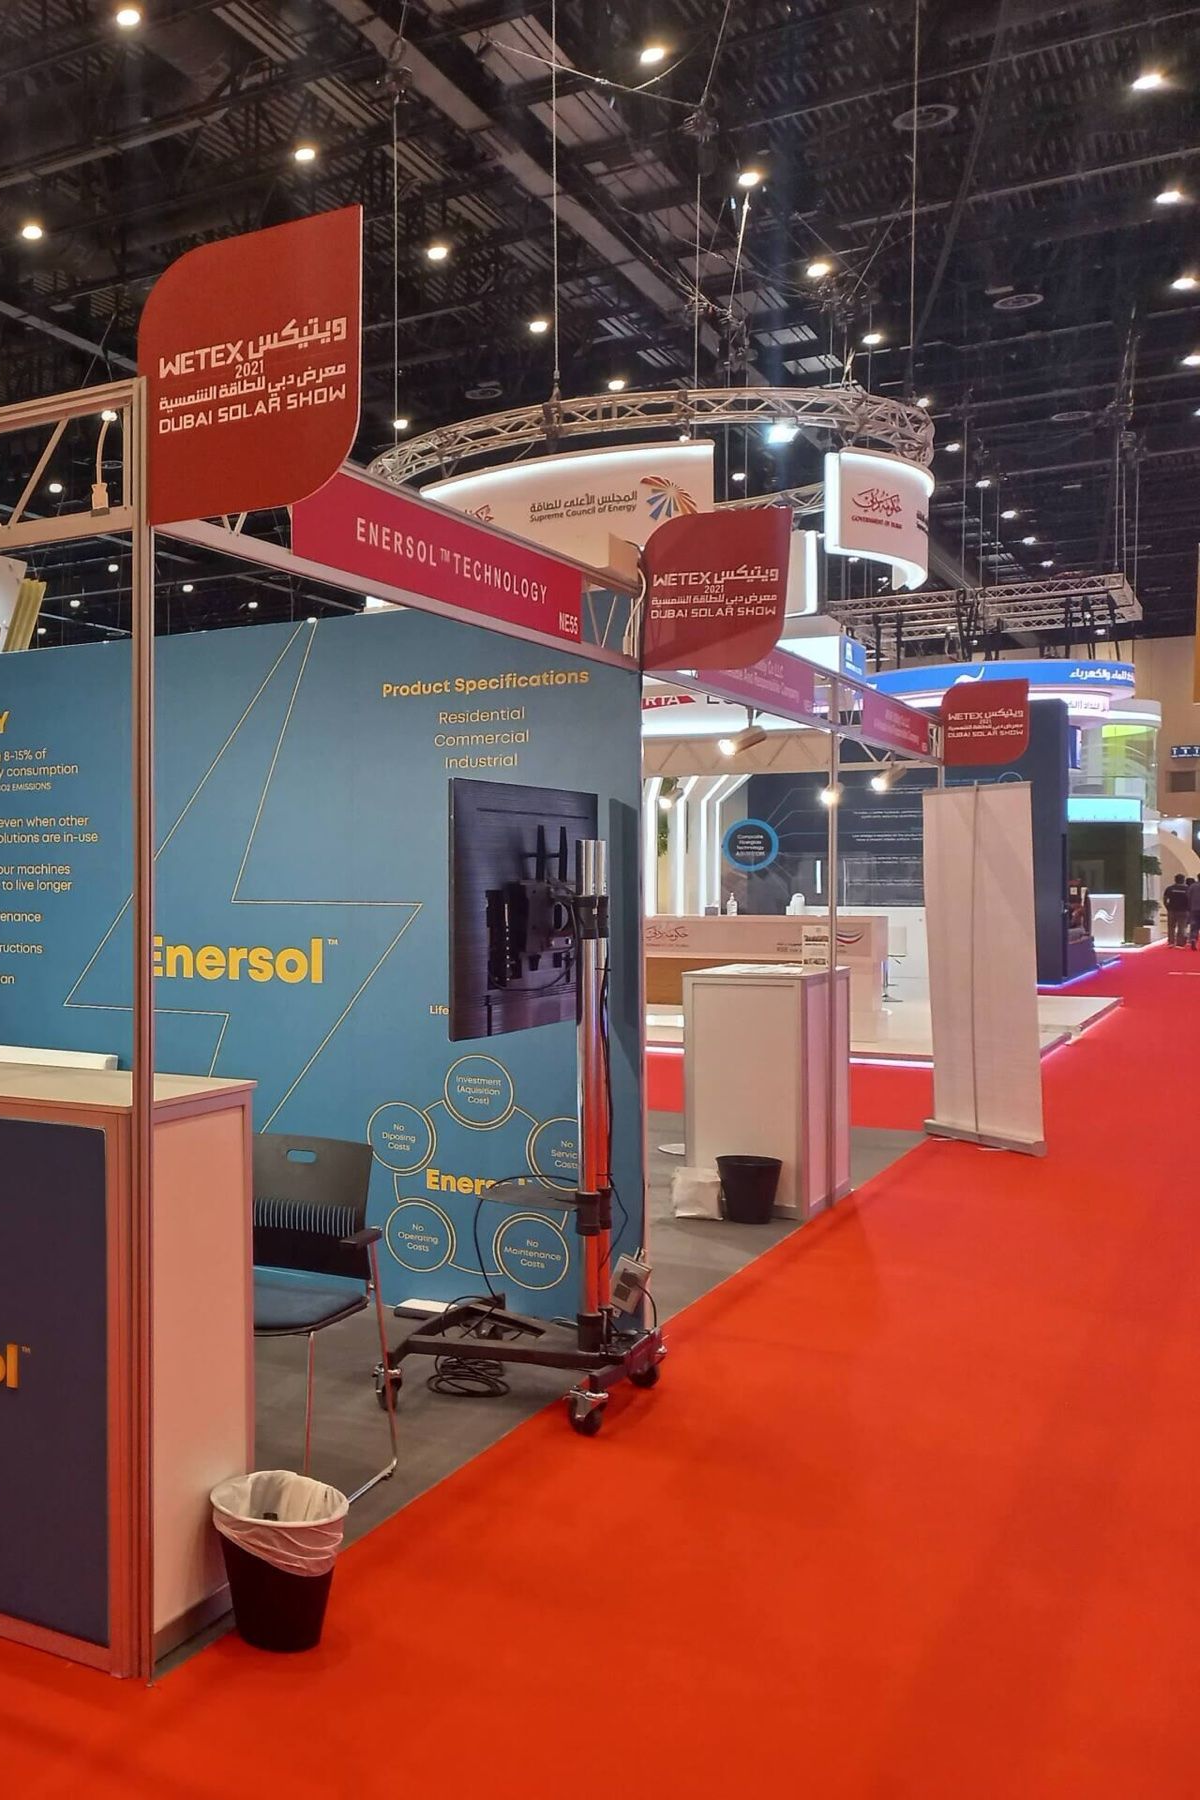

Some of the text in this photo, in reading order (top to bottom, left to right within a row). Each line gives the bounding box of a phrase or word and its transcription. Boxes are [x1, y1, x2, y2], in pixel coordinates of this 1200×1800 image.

[248, 316, 347, 360] ويتيكس
[159, 340, 244, 379] WETEX
[234, 359, 265, 378] 2021
[159, 363, 346, 413] معرض دبي للطاقة الشمسية
[159, 383, 347, 434] DUBAI SOLAR SHOW
[597, 491, 637, 506] المجلس
[530, 503, 637, 523] Supreme Council of Energy
[452, 552, 547, 604] TECHNOLOGY
[653, 571, 712, 587] WETEX
[714, 564, 779, 584] ويتيكس
[704, 584, 725, 594] 2021
[651, 606, 777, 619] DUBAI SOLAR SHOW
[559, 612, 578, 635] NE55
[382, 671, 589, 697] Product Specifications
[645, 696, 680, 706] RTA
[439, 706, 525, 725] Residential
[948, 712, 983, 720] WETEX
[434, 729, 530, 747] Commercial
[4, 750, 33, 762] 8-15%
[35, 748, 48, 760] of
[445, 753, 518, 769] Industrial
[6, 763, 79, 779] consumption
[12, 782, 52, 792] EMISSIONS
[26, 815, 56, 828] when
[58, 814, 89, 827] other
[41, 833, 61, 844] are
[63, 831, 98, 844] in-use
[17, 863, 71, 876] machines
[2, 881, 13, 891] to
[15, 879, 35, 891] live
[36, 879, 72, 893] longer
[456, 1075, 501, 1087] Investment
[457, 1085, 500, 1096] (Aquisition
[467, 1096, 490, 1105] Cost)
[393, 1124, 404, 1132] No
[382, 1131, 416, 1144] Diposing
[560, 1139, 574, 1148] No
[388, 1142, 411, 1152] Costs
[551, 1149, 578, 1160] Servic
[412, 1223, 424, 1232] No
[398, 1231, 439, 1244] Operating
[526, 1239, 539, 1248] No
[407, 1242, 430, 1252] Costs
[504, 1246, 562, 1261] Maintenance
[520, 1258, 545, 1270] Costs
